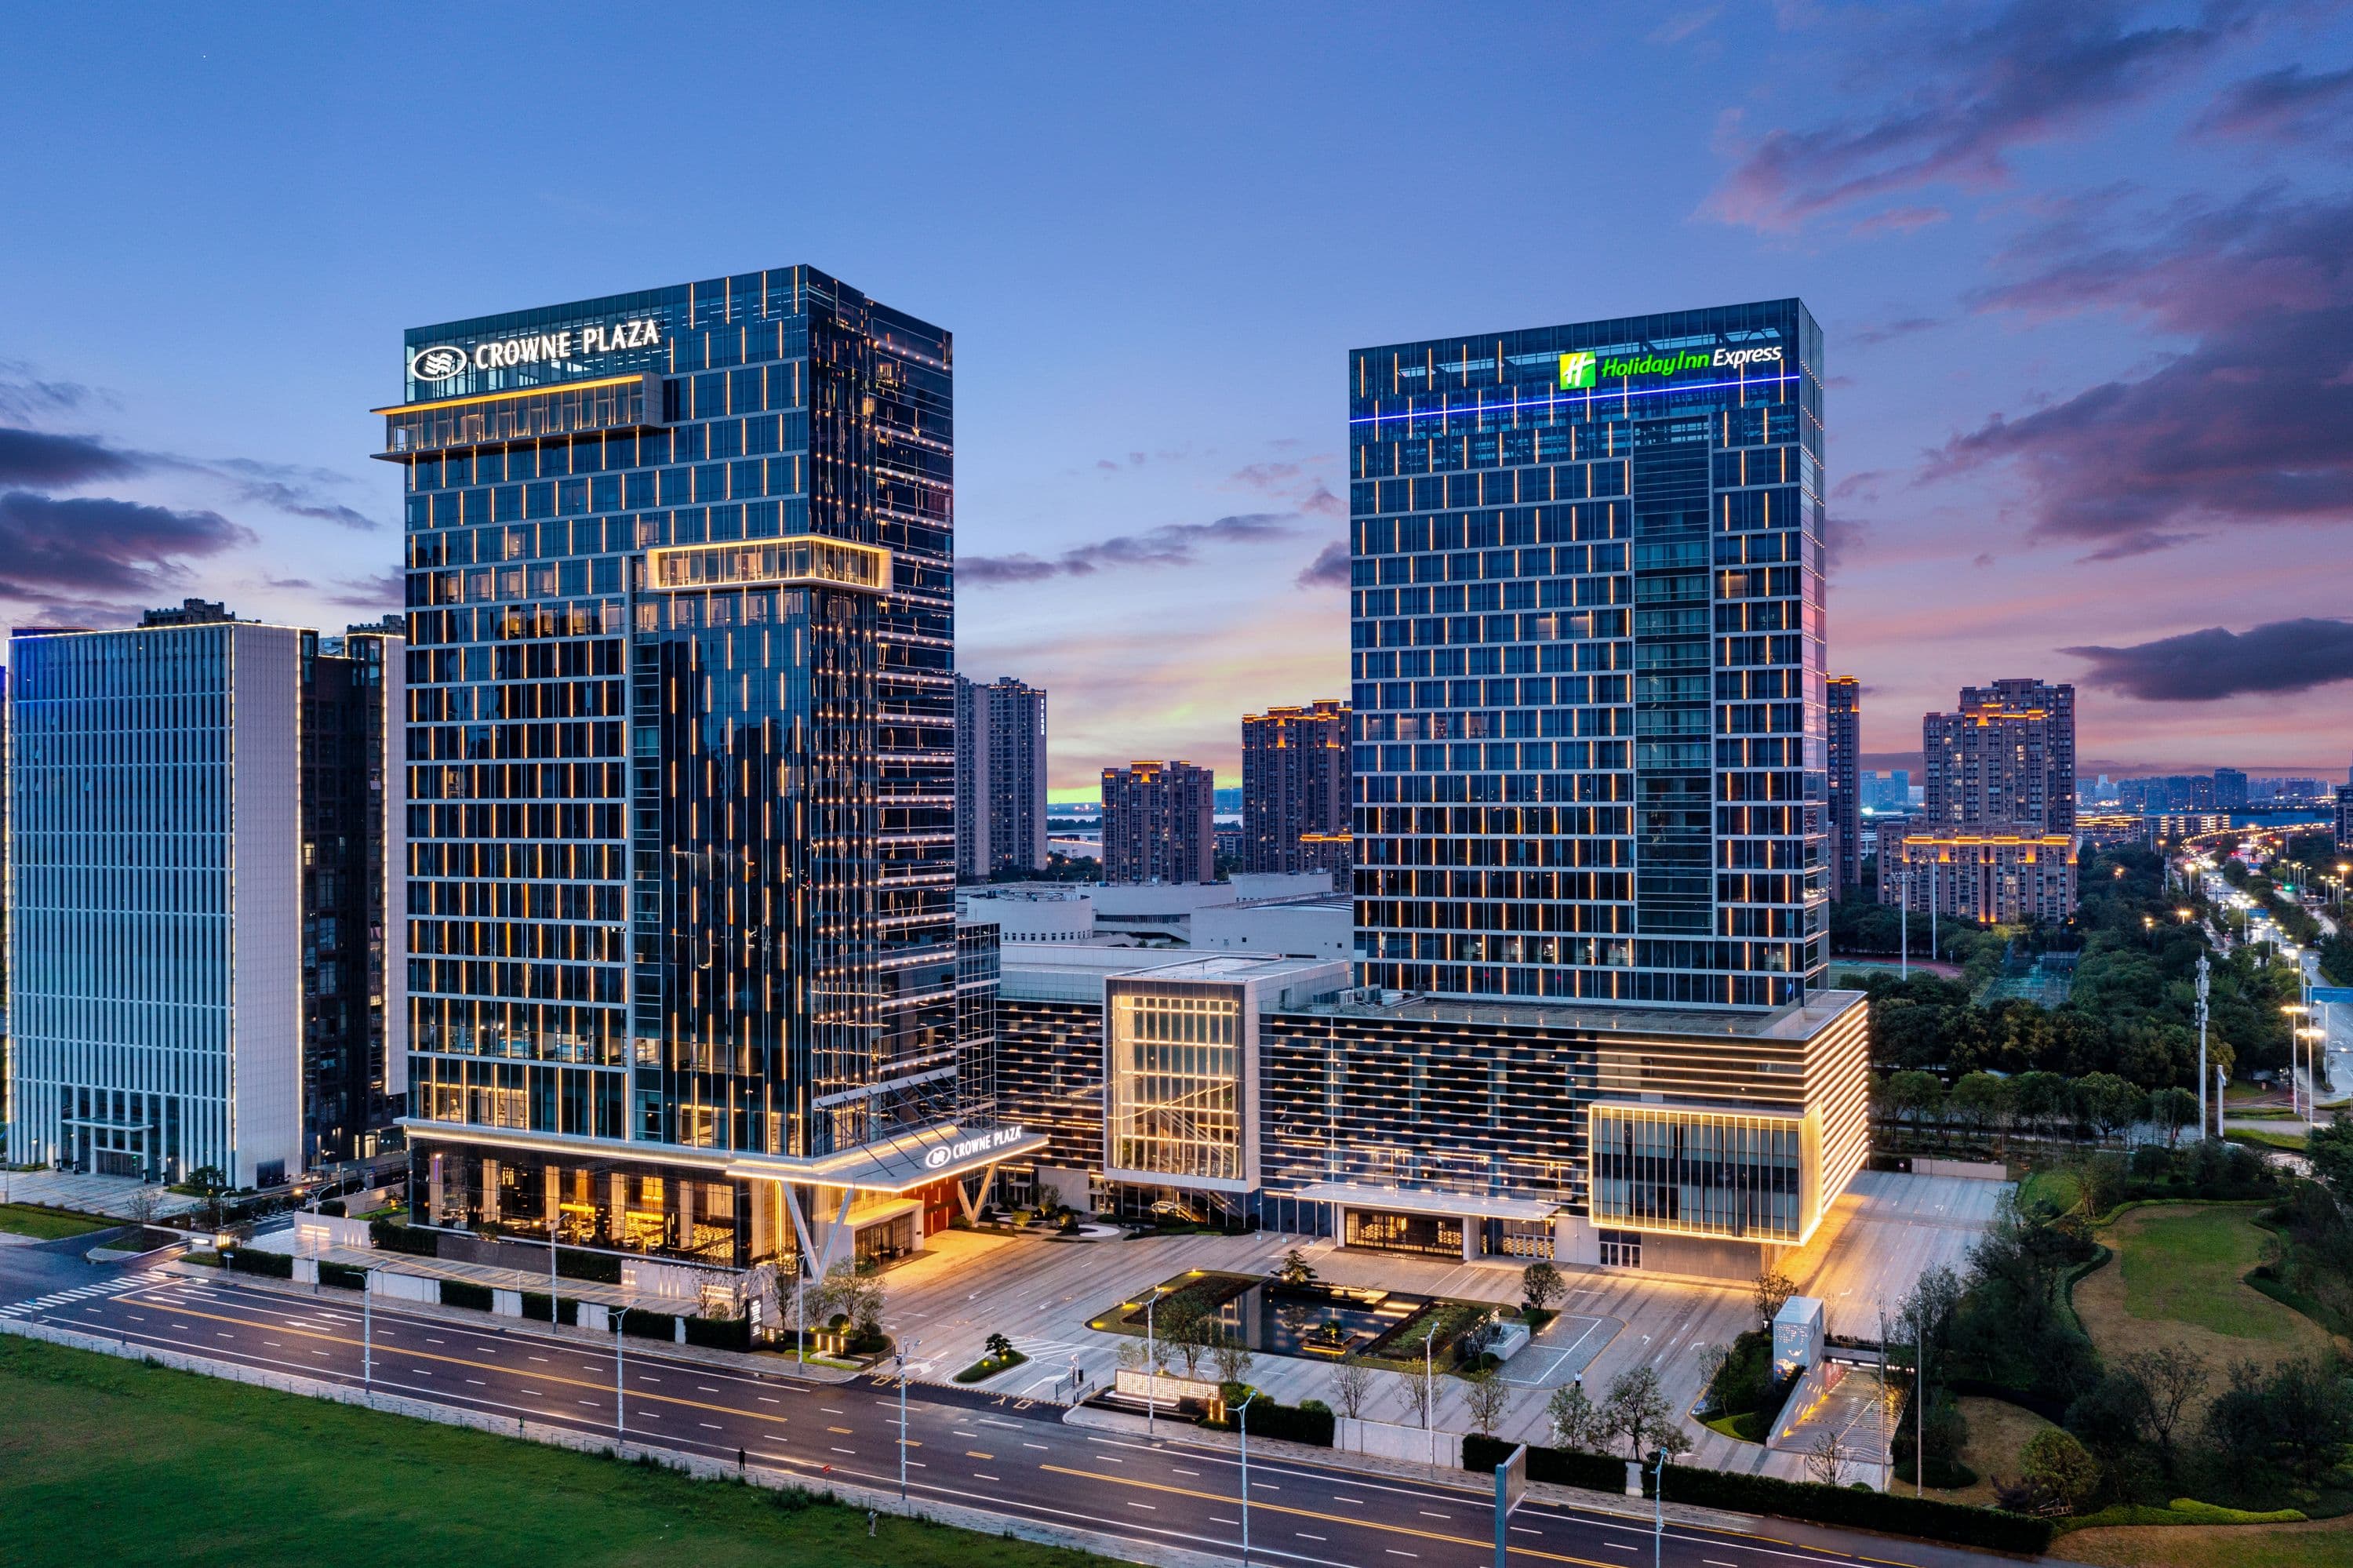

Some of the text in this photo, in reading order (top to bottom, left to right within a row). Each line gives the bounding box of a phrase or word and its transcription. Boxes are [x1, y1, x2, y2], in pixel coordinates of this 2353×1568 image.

[475, 318, 659, 369] CROWNE PLAZA
[1713, 347, 1782, 369] Express
[953, 1126, 1022, 1159] CROWNE PLAZA
